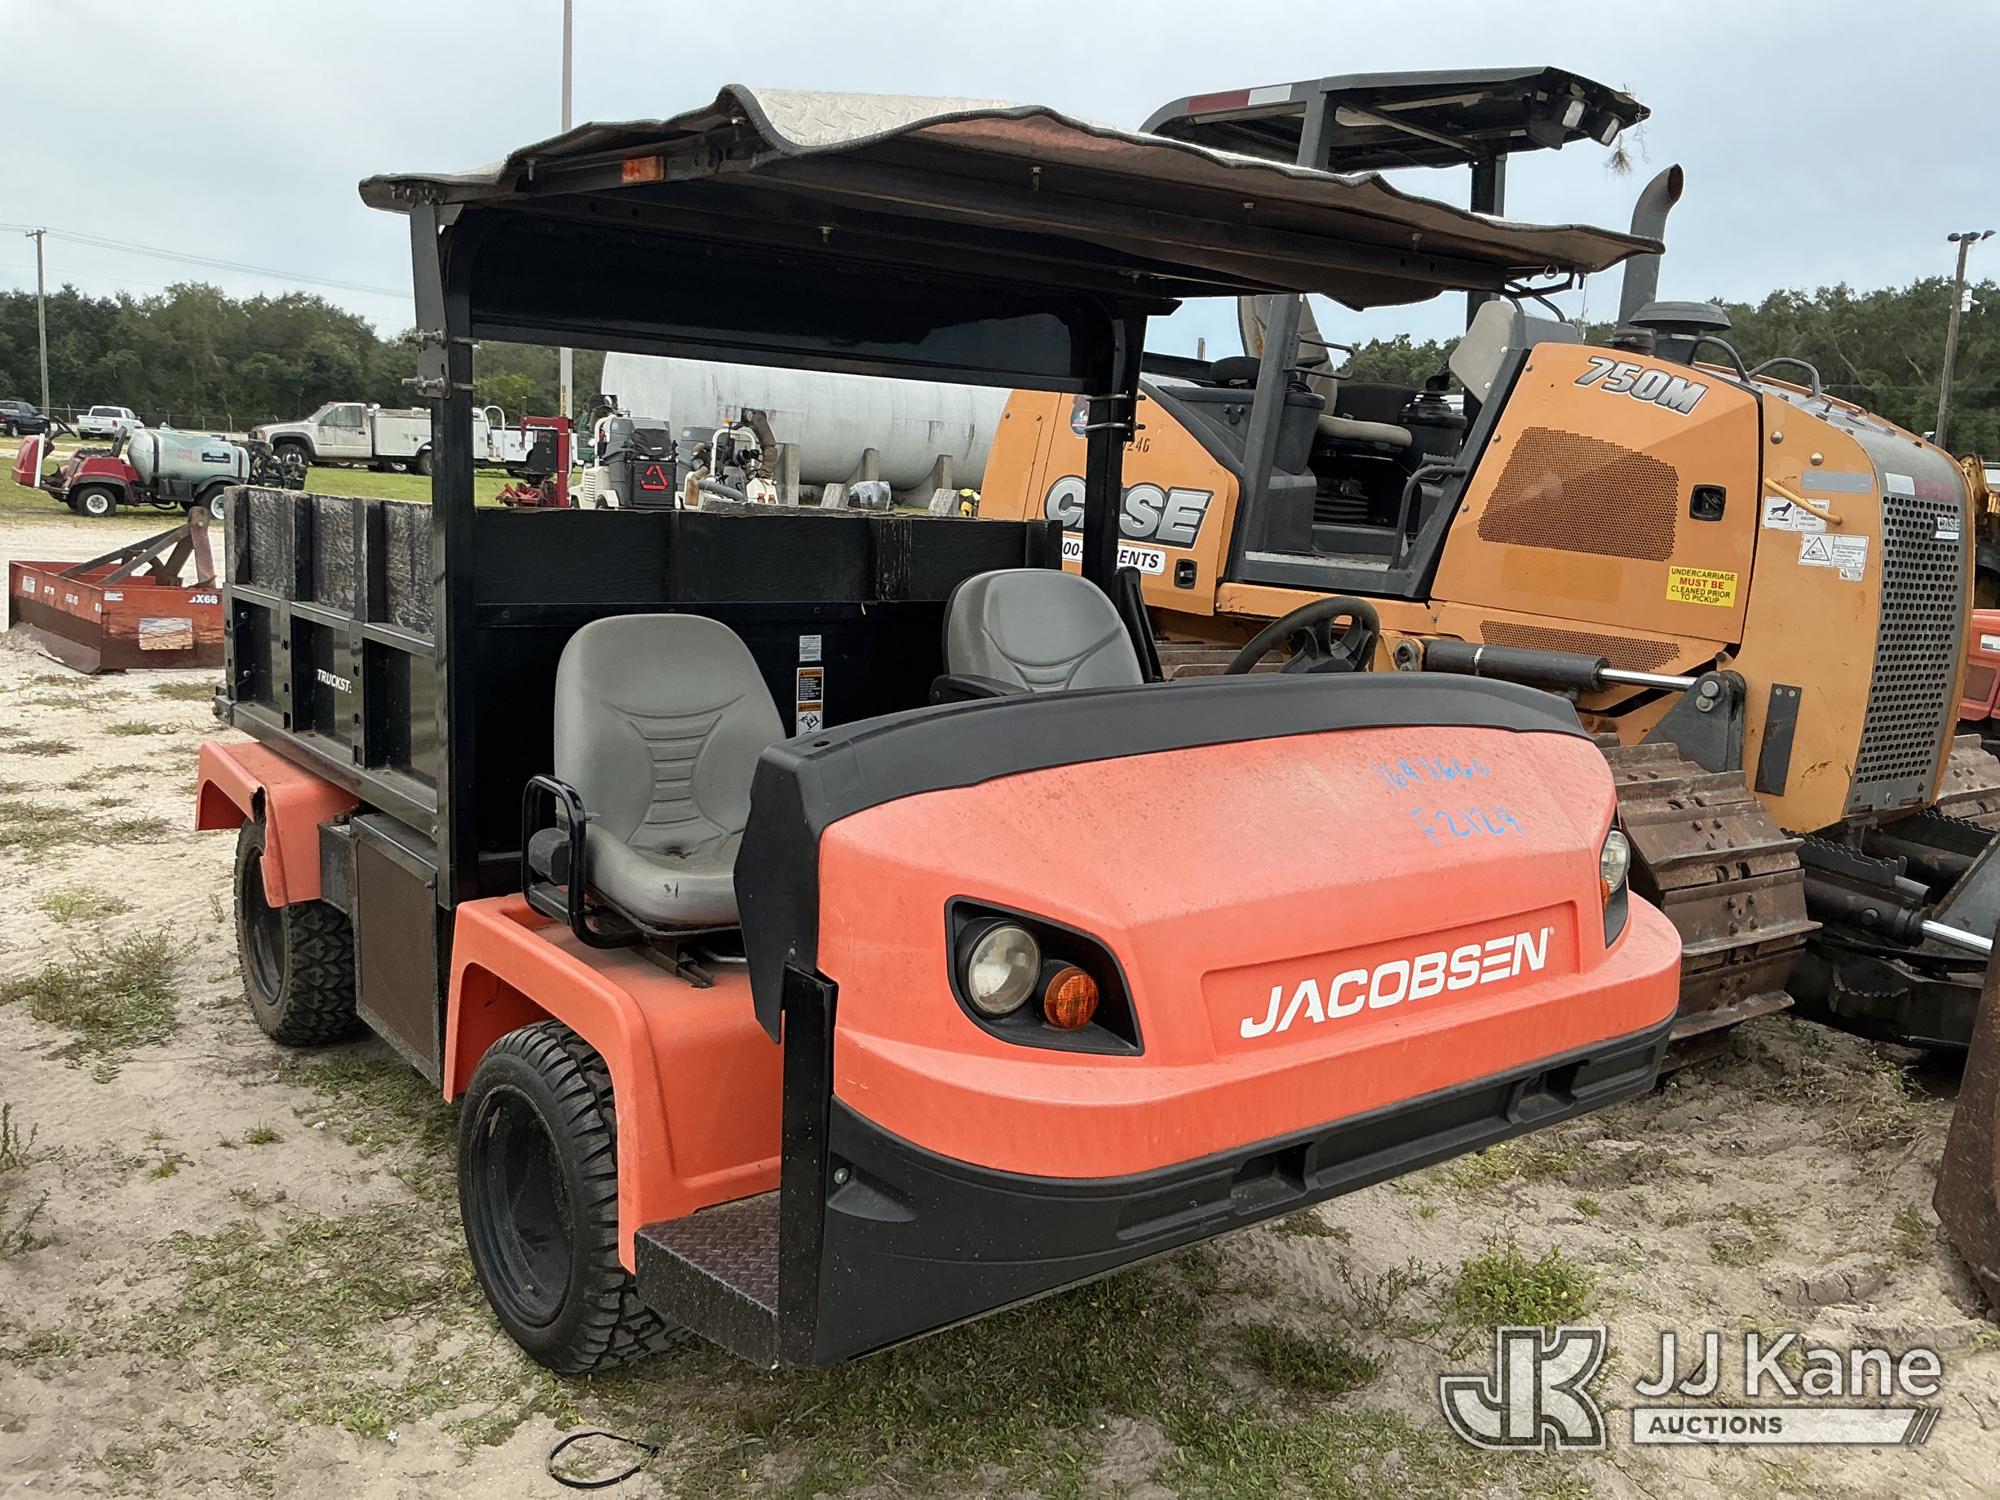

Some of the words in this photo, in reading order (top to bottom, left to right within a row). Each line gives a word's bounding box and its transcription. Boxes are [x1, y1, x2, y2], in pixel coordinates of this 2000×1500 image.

[1574, 355, 1710, 415] 750M
[1045, 475, 1211, 544] CSE
[1671, 568, 1735, 581] UNDERCARRIAGE
[1680, 577, 1708, 587] MUST
[1711, 581, 1724, 589] BE
[1671, 585, 1705, 596] CLEANED
[1707, 589, 1731, 599] PRIOR
[1681, 593, 1690, 601] TO
[1692, 594, 1720, 604] PICKUP
[317, 669, 352, 693] TRUCKST
[1241, 927, 1549, 1038] JACOBSEN
